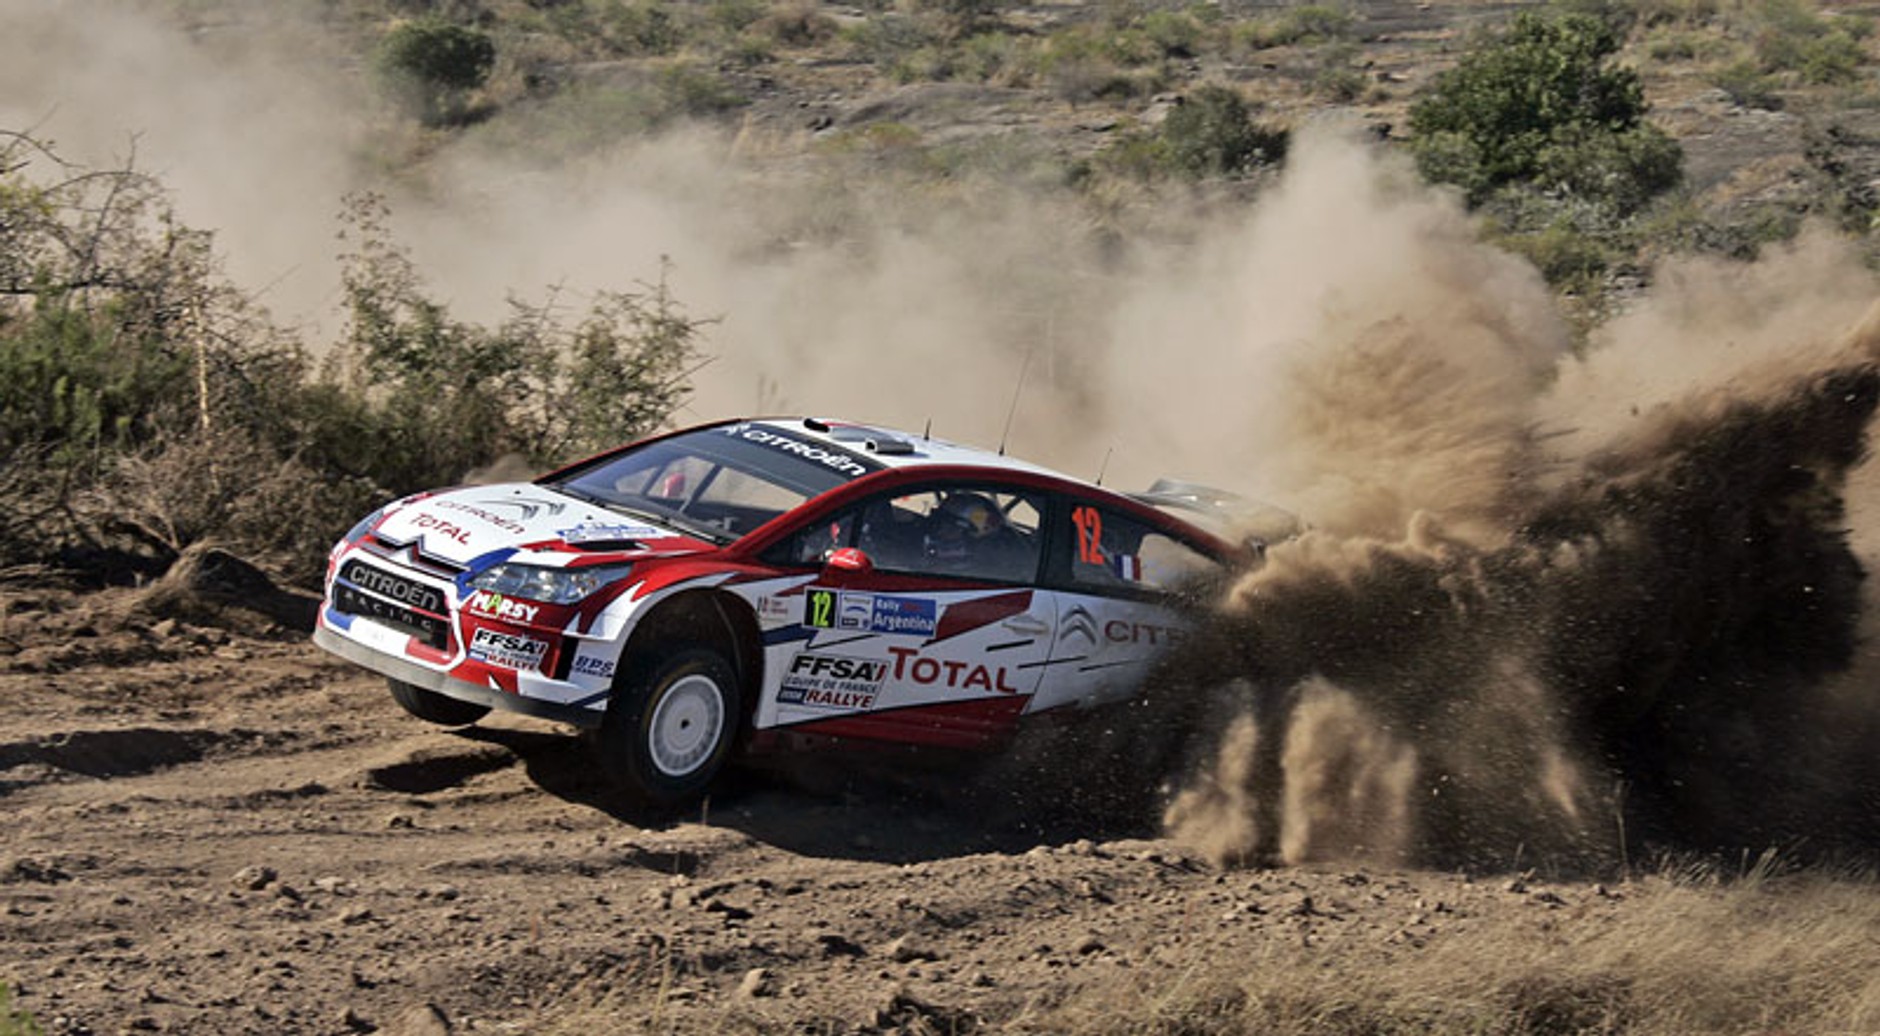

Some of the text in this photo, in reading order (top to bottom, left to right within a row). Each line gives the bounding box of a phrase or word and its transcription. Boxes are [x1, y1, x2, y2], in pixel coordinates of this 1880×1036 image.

[410, 512, 471, 546] TOTAL
[1072, 507, 1104, 565] 12
[472, 590, 539, 622] MARSY
[812, 591, 831, 628] 12
[876, 598, 900, 612] Rally
[874, 611, 935, 631] Argentina
[1104, 619, 1190, 646] CITR
[888, 646, 1017, 694] TOTAL
[806, 688, 874, 708] RALLYE
[838, 681, 877, 693] FRANCE
